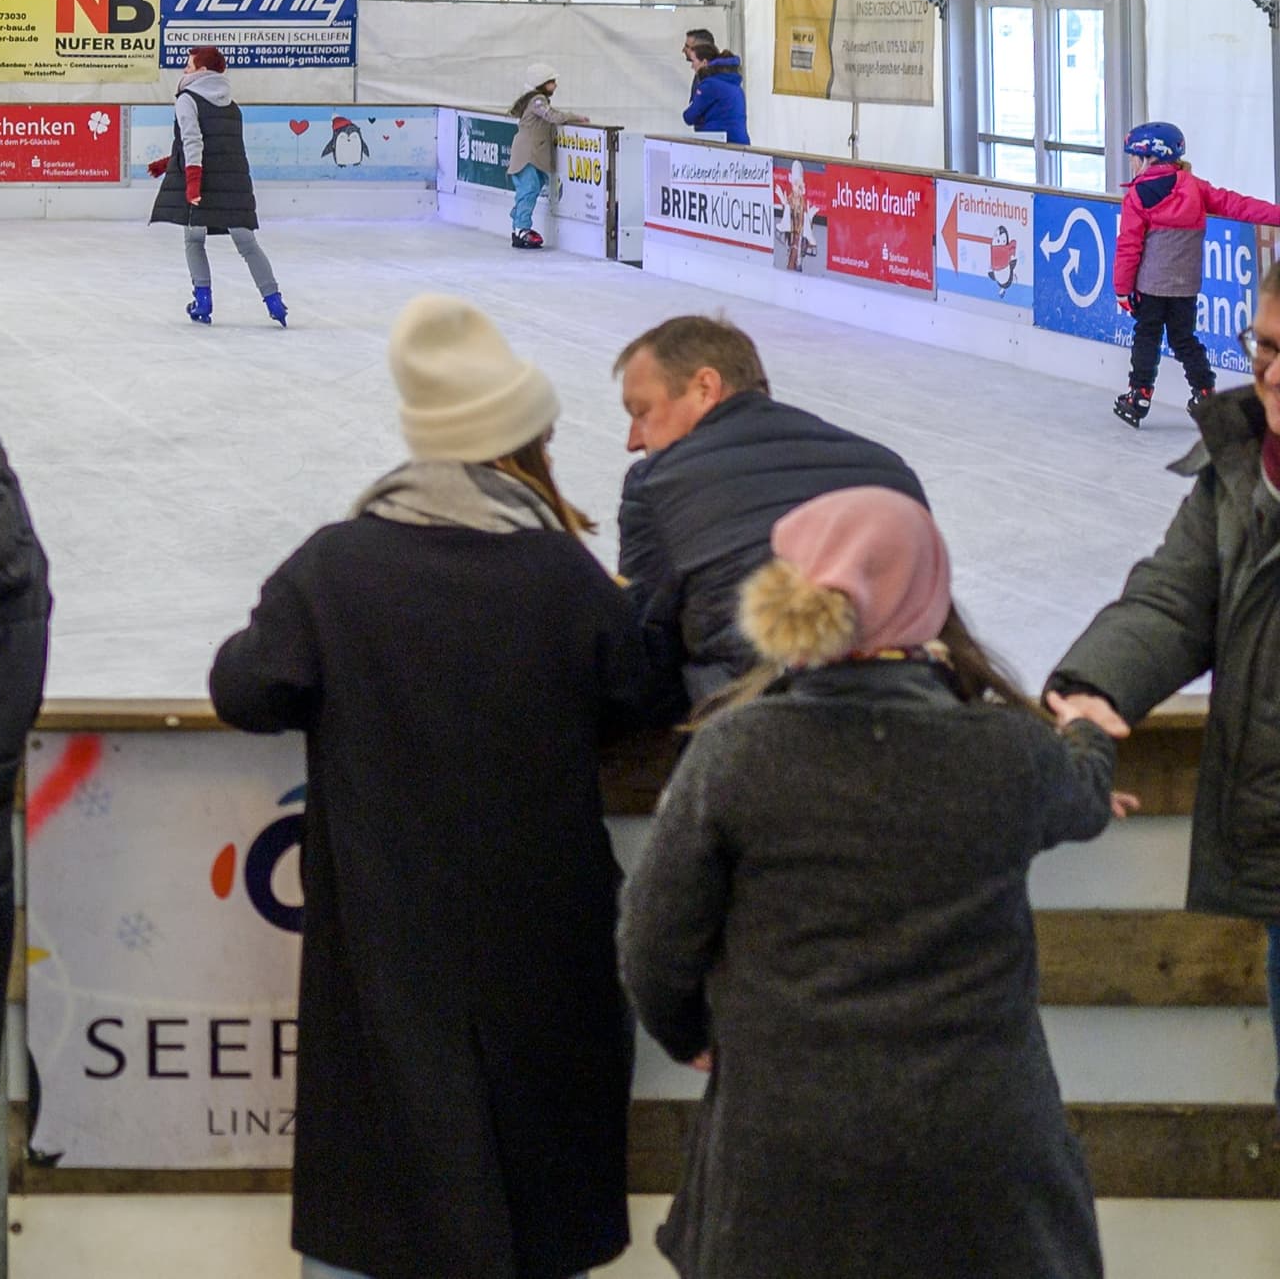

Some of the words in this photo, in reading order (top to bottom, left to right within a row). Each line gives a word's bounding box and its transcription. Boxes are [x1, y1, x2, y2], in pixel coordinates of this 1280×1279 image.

[167, 32, 190, 42] CNC
[192, 32, 236, 42] DREHEN
[244, 30, 285, 43] FRÄSEN
[293, 32, 349, 42] SCHLEIFEN
[55, 38, 115, 51] NUFER
[121, 38, 156, 51] BAU
[166, 46, 178, 55] IM
[237, 46, 249, 55] 20
[255, 46, 283, 55] 88630
[285, 46, 350, 55] PFULLENDORF
[259, 55, 350, 67] hennig-gmbh.com
[5, 138, 19, 146] dem
[471, 139, 499, 166] STOCKER
[43, 160, 75, 170] Sparkasse
[567, 154, 602, 187] LANG
[855, 186, 880, 212] steh
[661, 185, 709, 224] BRIER
[711, 190, 772, 237] KÜCHEN
[959, 192, 1028, 226] Fahrtrichtung
